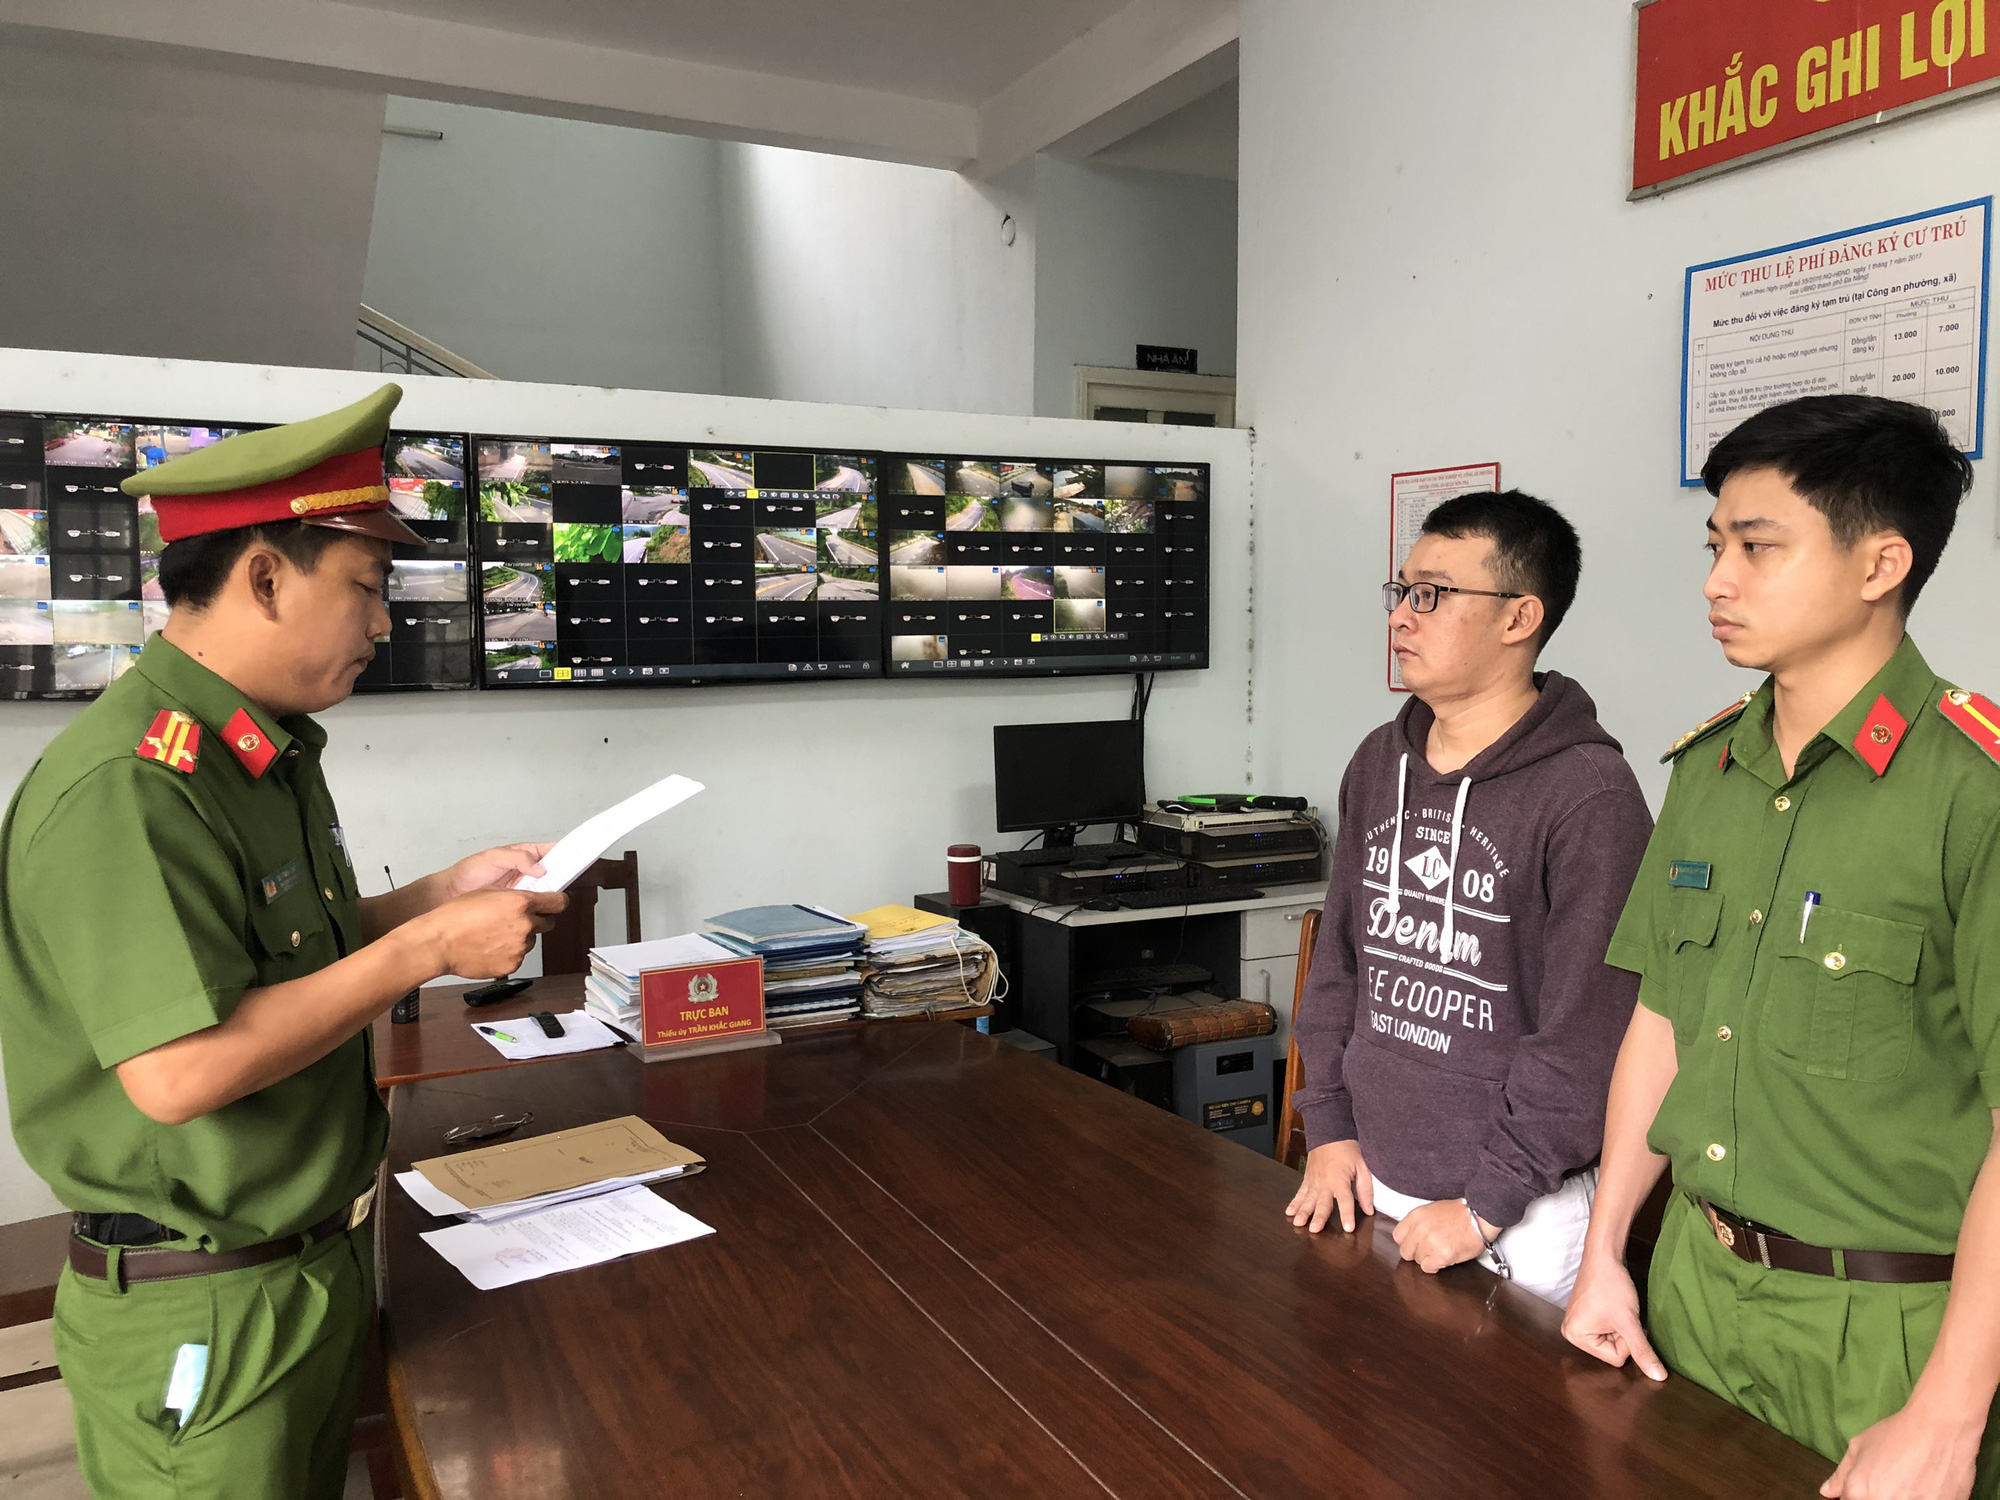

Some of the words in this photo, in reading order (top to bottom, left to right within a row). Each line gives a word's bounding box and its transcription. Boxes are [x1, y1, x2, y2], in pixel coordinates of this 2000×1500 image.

[1659, 51, 1778, 161] KHẮC
[1796, 24, 1881, 114] GHI
[1705, 271, 1738, 292] MỨC
[1741, 265, 1772, 284] THU
[1775, 256, 1795, 278] LỆ
[1798, 248, 1825, 272] PHÍ
[1829, 243, 1873, 265] ĐĂNG
[1877, 231, 1900, 254] KÝ
[1903, 226, 1928, 248] CƯ
[1931, 215, 1967, 242] TRÚ
[1713, 318, 1729, 328] Mức
[1731, 316, 1743, 325] thu
[1745, 312, 1757, 322] đối
[1758, 309, 1771, 319] với
[1773, 307, 1789, 317] việc
[1790, 303, 1810, 313] đăng
[1811, 299, 1821, 310] ký
[1822, 298, 1837, 308] tạm
[1839, 293, 1850, 303] trú
[1852, 290, 1865, 303] (tại
[1867, 288, 1889, 299] Công
[1891, 285, 1901, 293] an
[1903, 277, 1941, 293] phường,
[1943, 272, 1957, 283] xã)
[1894, 330, 1918, 340] 13.000
[1939, 323, 1959, 333] 7.000
[1892, 372, 1916, 383] 20.000
[1935, 365, 1960, 376] 10.000
[1415, 826, 1451, 845] SINCE
[1422, 808, 1453, 825] BRITIS
[1470, 826, 1510, 878] HERITAGE
[1365, 845, 1389, 875] 19
[1463, 869, 1495, 903] 08
[1421, 855, 1441, 880] LC
[1403, 888, 1424, 900] QUALITY
[1366, 897, 1482, 967] Denm
[1398, 954, 1424, 968] CRAFTED
[1424, 962, 1444, 973] GOODS
[680, 1009, 707, 1022] TRỰC
[709, 1006, 729, 1017] BAN
[1391, 975, 1494, 1032] COOPER
[657, 1028, 677, 1039] Thiếu
[688, 1024, 708, 1034] TRẦN
[709, 1021, 728, 1032] KHẮC
[729, 1019, 752, 1029] GIANG
[1395, 1018, 1452, 1054] LONDON
